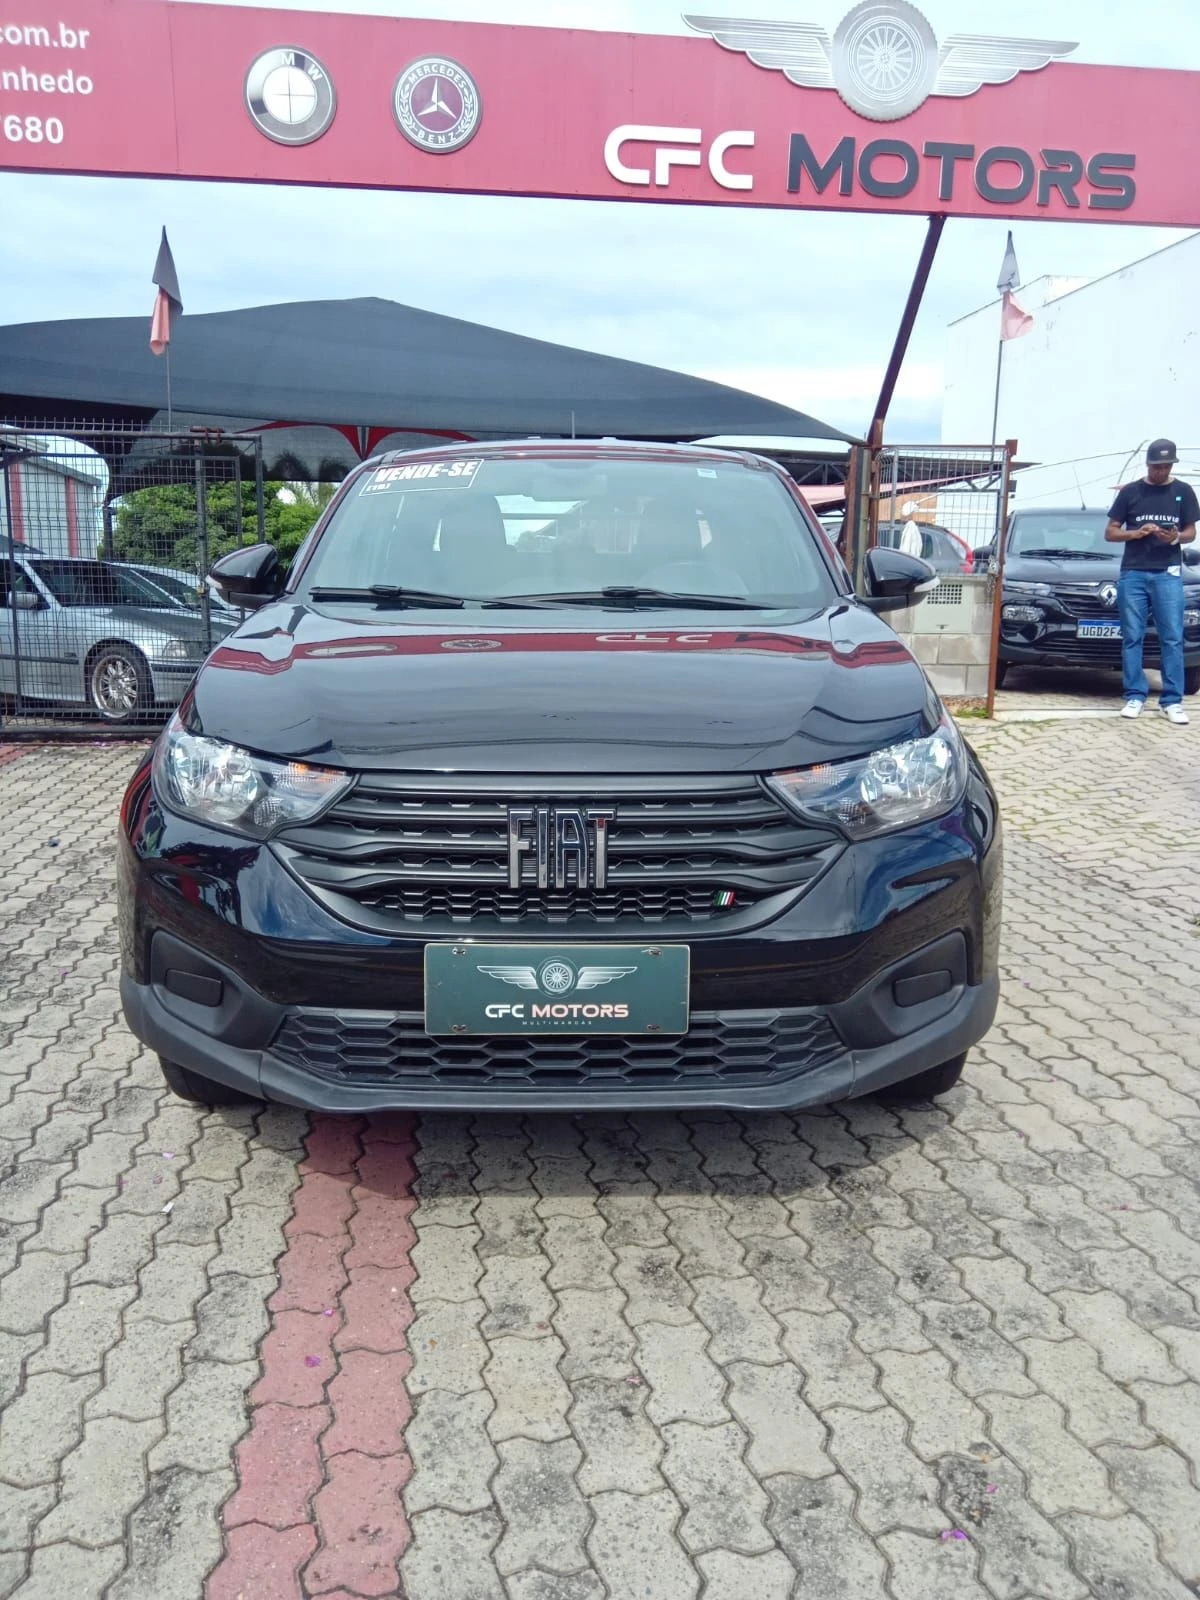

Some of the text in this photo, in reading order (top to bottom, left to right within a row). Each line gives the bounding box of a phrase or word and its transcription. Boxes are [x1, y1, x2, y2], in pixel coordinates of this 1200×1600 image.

[0, 21, 90, 49] om.br
[0, 65, 94, 95] nhedo
[407, 64, 467, 88] MERCEDES
[0, 114, 64, 144] 680
[417, 131, 457, 144] BENZ
[603, 124, 1136, 210] CFC MOTORS
[374, 461, 479, 483] VENDE-SE
[507, 807, 617, 890] FIAT
[485, 1003, 630, 1018] CFC MOTORS
